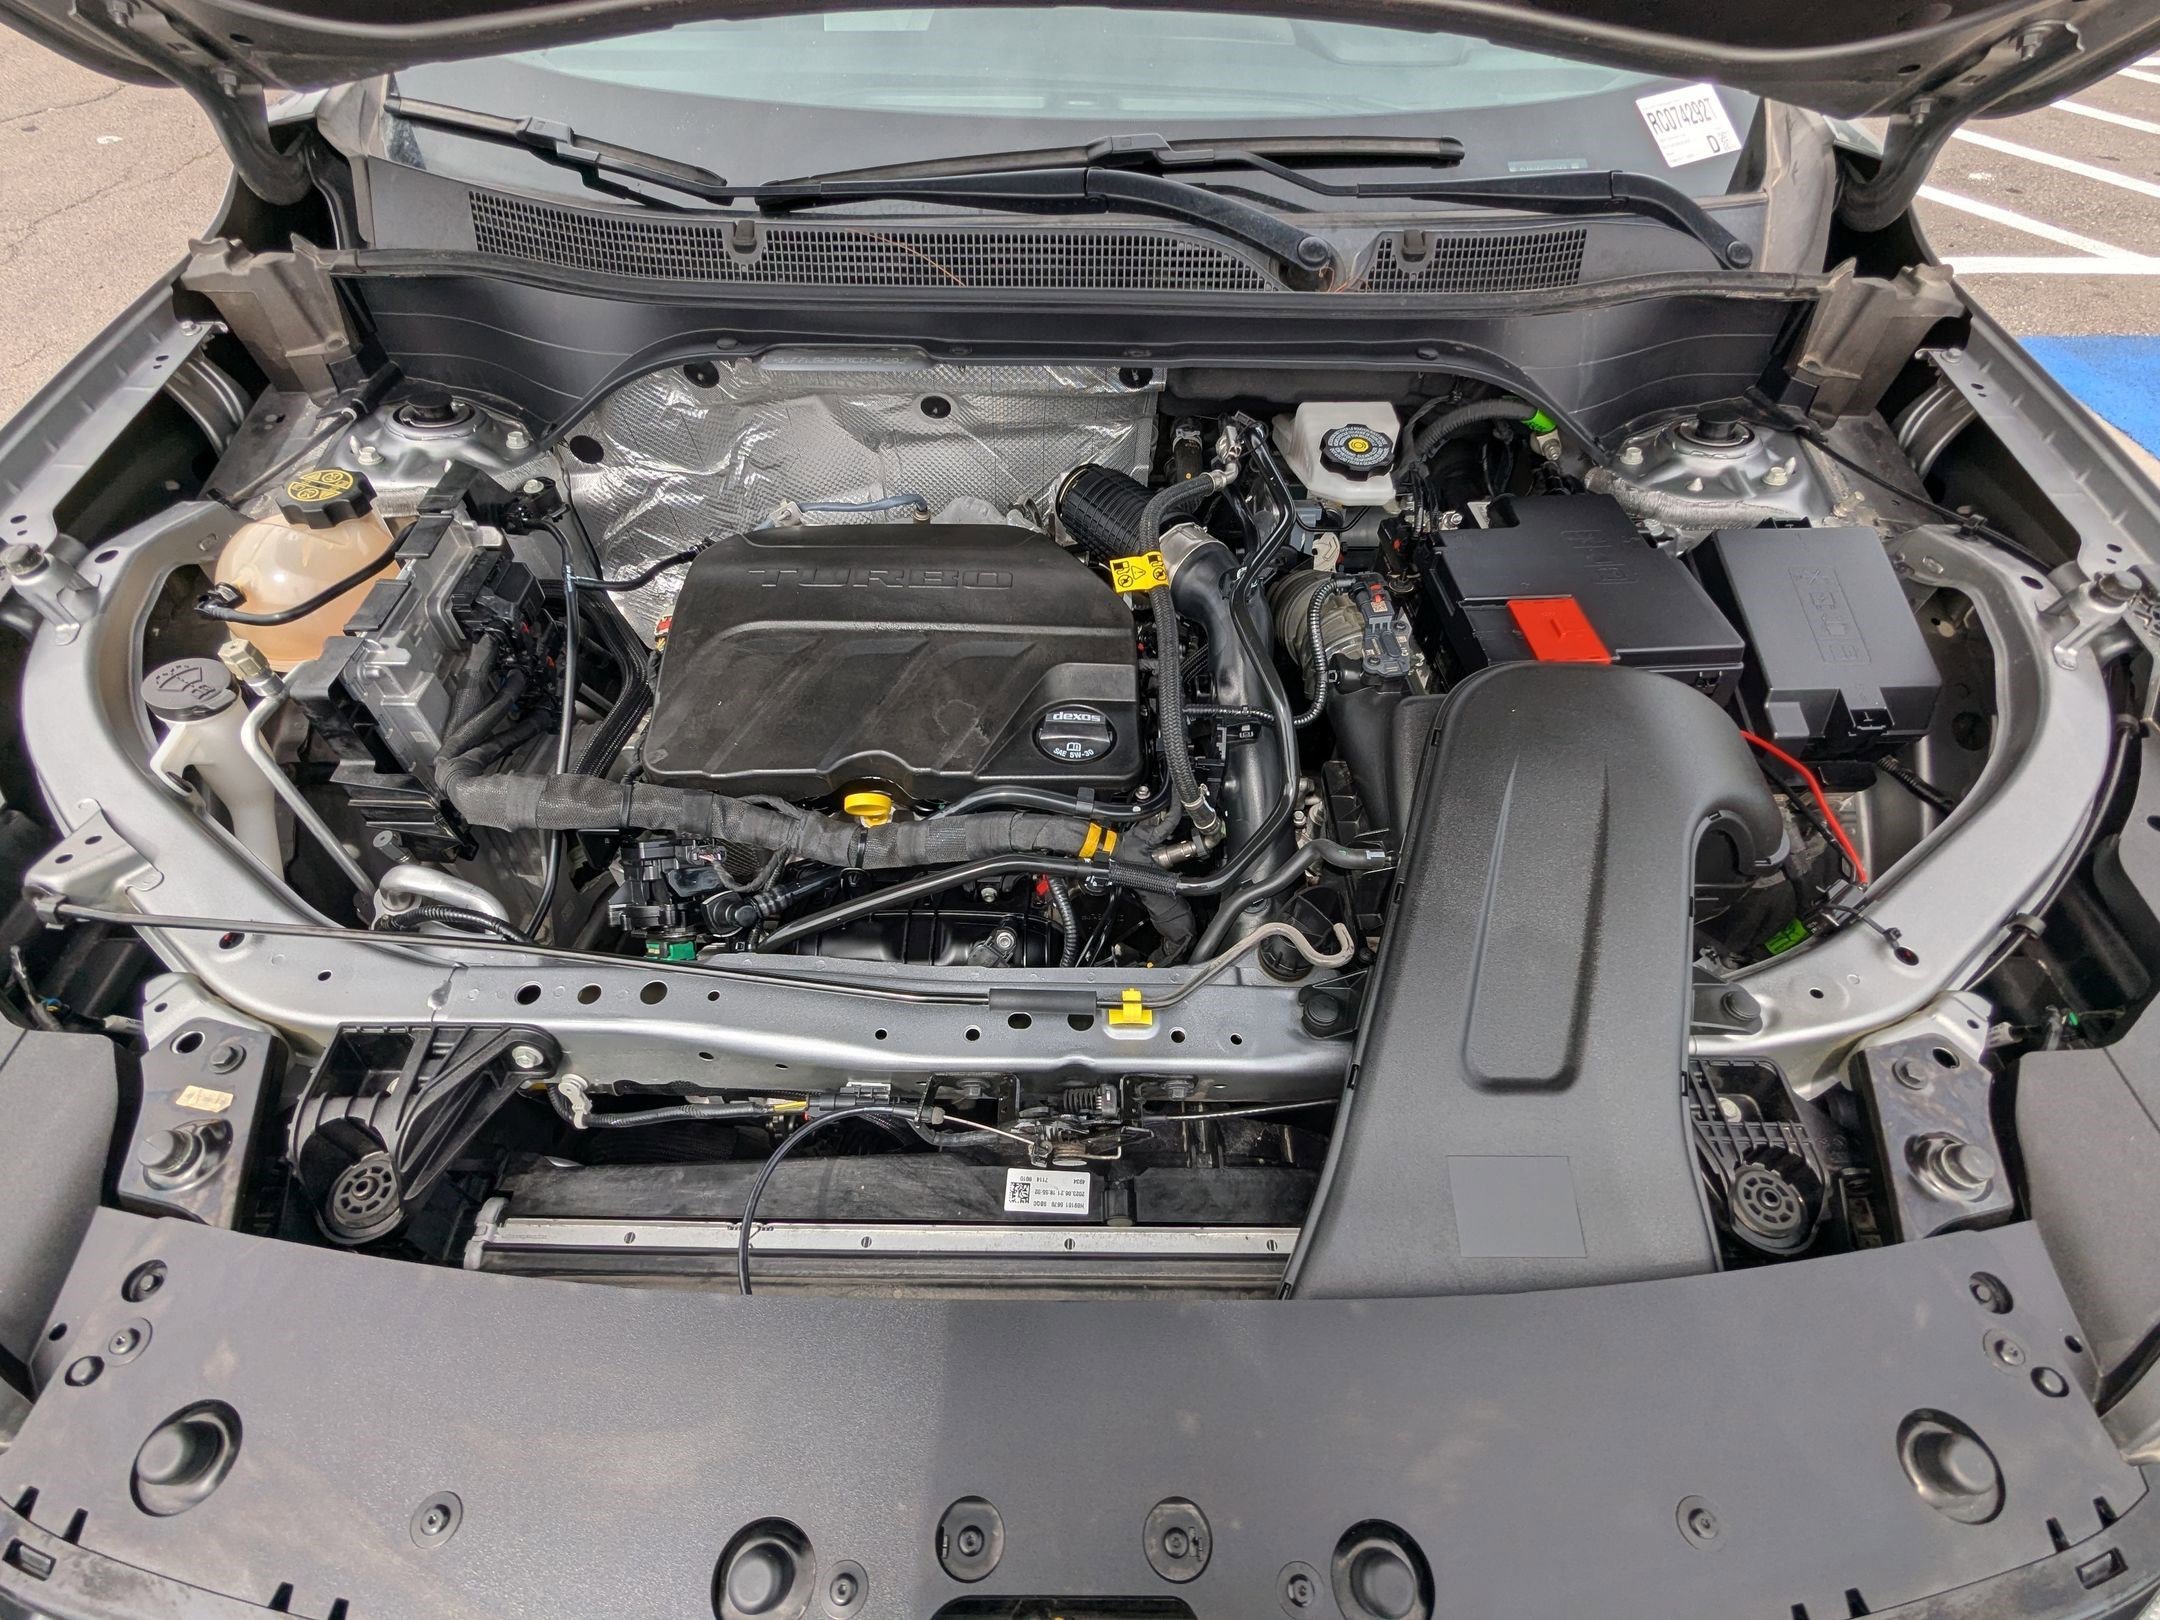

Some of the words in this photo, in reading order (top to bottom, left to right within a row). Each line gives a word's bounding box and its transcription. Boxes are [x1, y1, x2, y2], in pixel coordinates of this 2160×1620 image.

[1706, 134, 1721, 153] D
[748, 567, 1013, 590] TURBO
[1053, 711, 1101, 722] dexos
[1053, 747, 1067, 758] SAE
